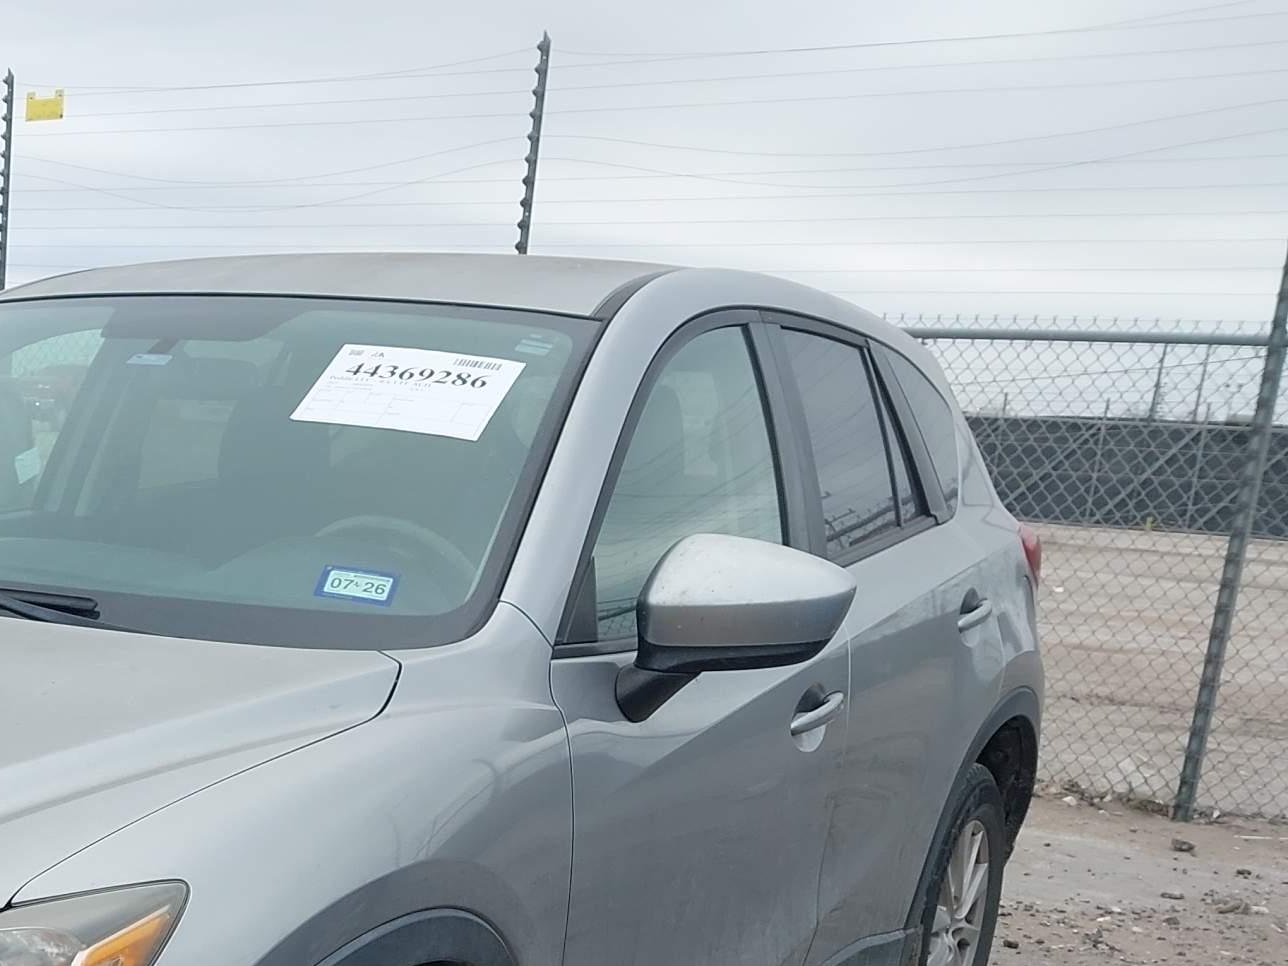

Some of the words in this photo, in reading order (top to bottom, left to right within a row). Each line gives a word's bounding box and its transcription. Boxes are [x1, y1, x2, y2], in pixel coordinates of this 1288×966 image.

[345, 362, 489, 389] 44369286
[330, 577, 354, 590] 07
[363, 581, 387, 596] 26
